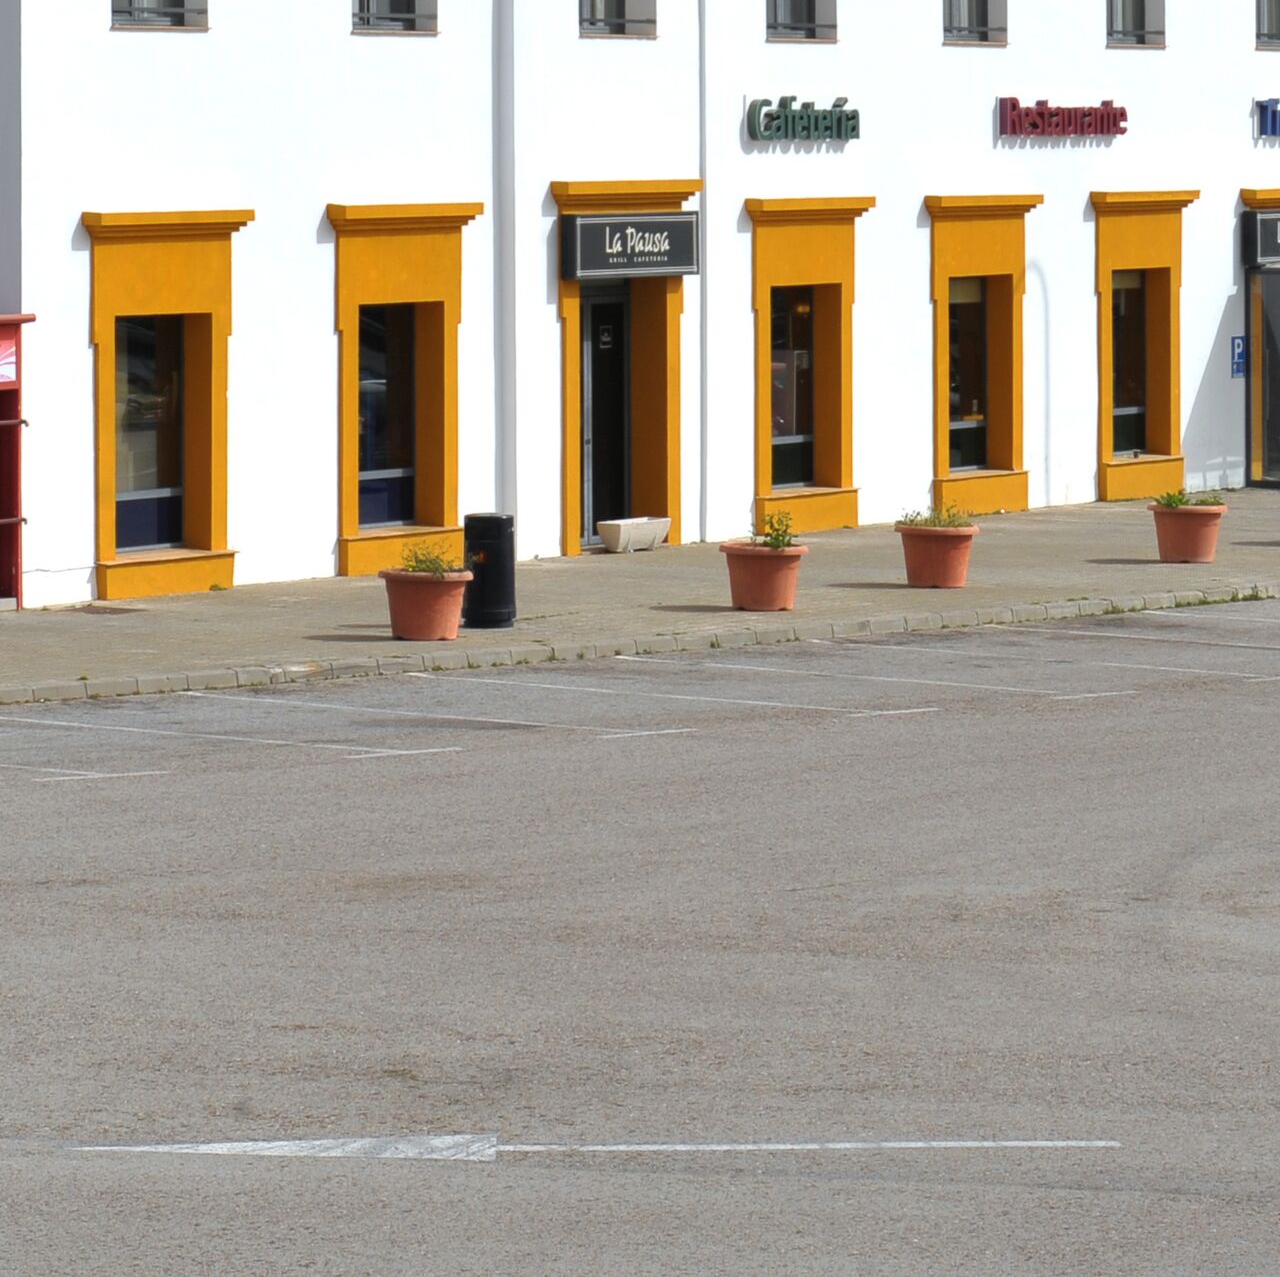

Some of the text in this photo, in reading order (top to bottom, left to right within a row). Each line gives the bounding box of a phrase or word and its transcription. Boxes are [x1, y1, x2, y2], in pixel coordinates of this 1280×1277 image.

[747, 95, 861, 141] Cafetería
[999, 96, 1129, 136] Restaurante
[605, 225, 671, 255] La Pausa
[1234, 338, 1243, 362] P
